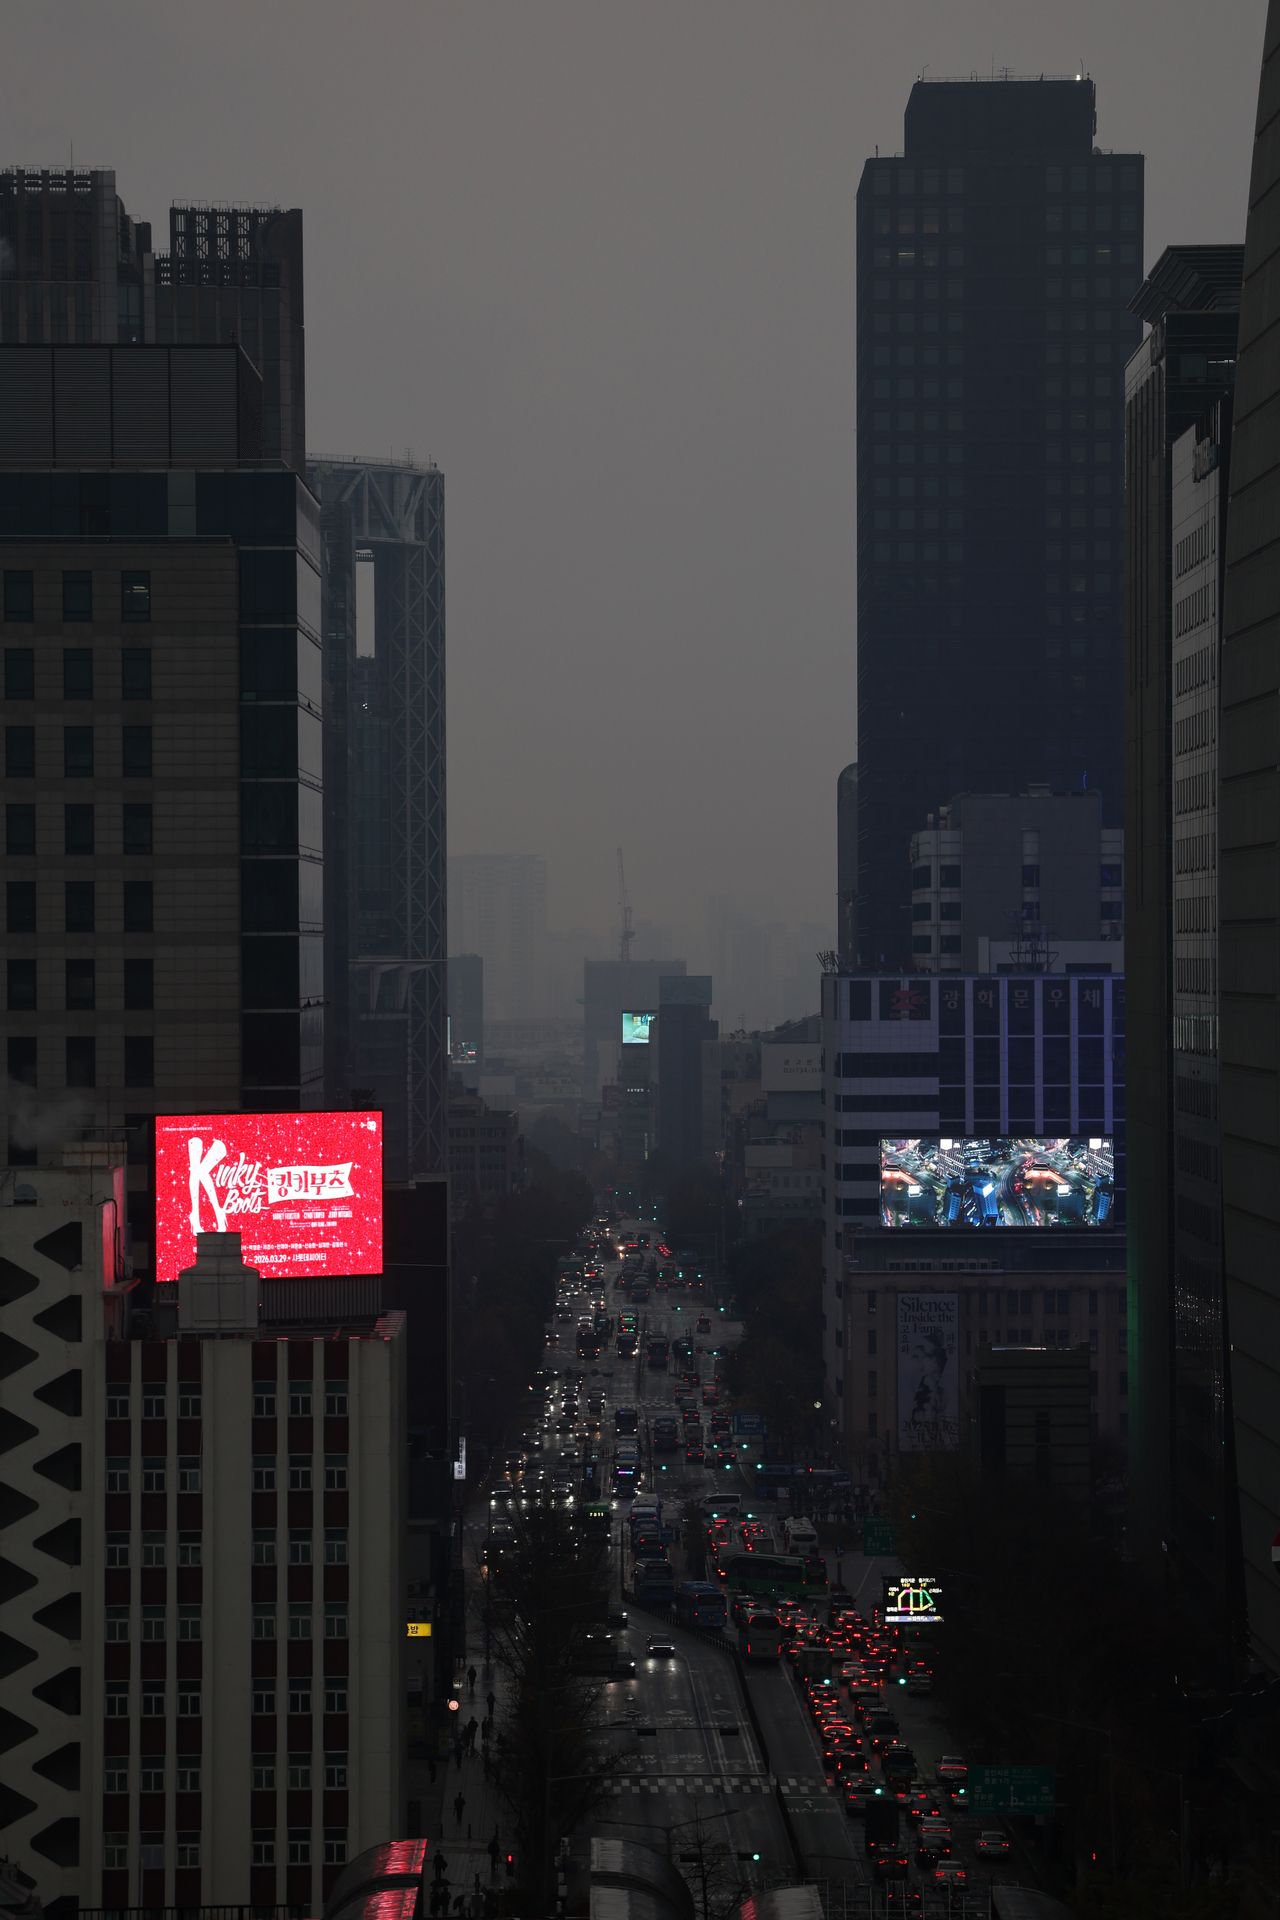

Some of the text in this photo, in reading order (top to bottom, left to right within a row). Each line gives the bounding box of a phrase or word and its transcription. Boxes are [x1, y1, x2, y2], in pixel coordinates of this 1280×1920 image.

[188, 1137, 267, 1235] Kinky
[275, 1170, 345, 1197] 킹키부츠
[224, 1188, 269, 1214] Boots
[900, 1296, 955, 1312] Silence
[938, 1312, 955, 1323] the
